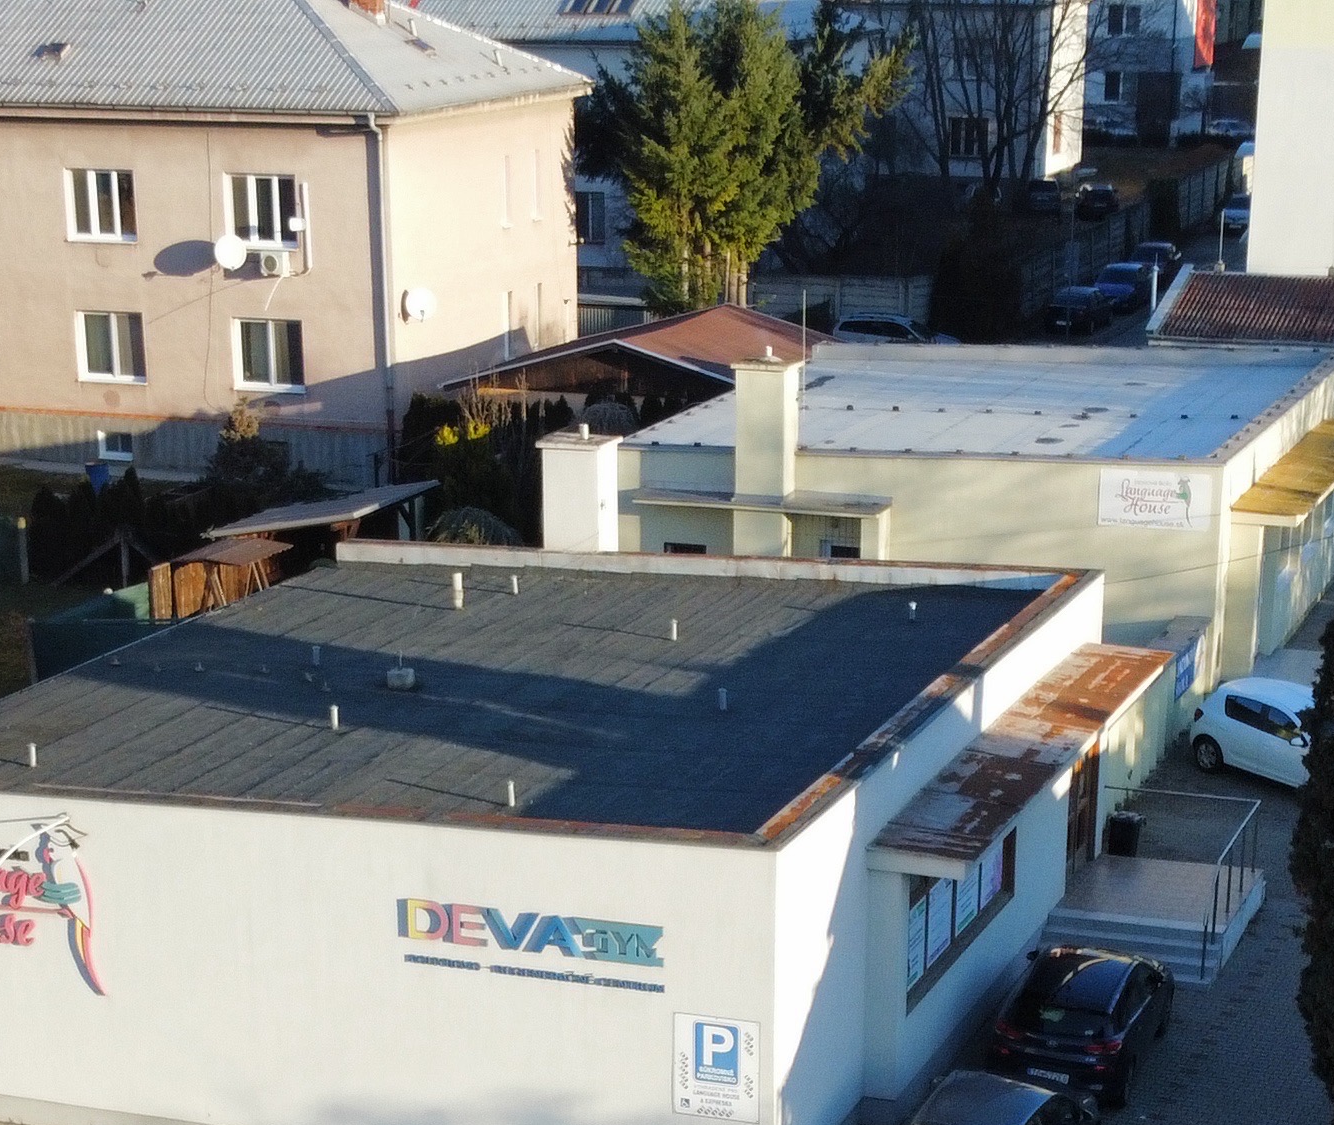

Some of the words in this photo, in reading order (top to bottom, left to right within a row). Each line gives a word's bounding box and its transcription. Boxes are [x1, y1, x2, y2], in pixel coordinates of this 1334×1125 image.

[1115, 478, 1176, 502] Language
[1123, 496, 1171, 516] House
[702, 1024, 735, 1066] P
